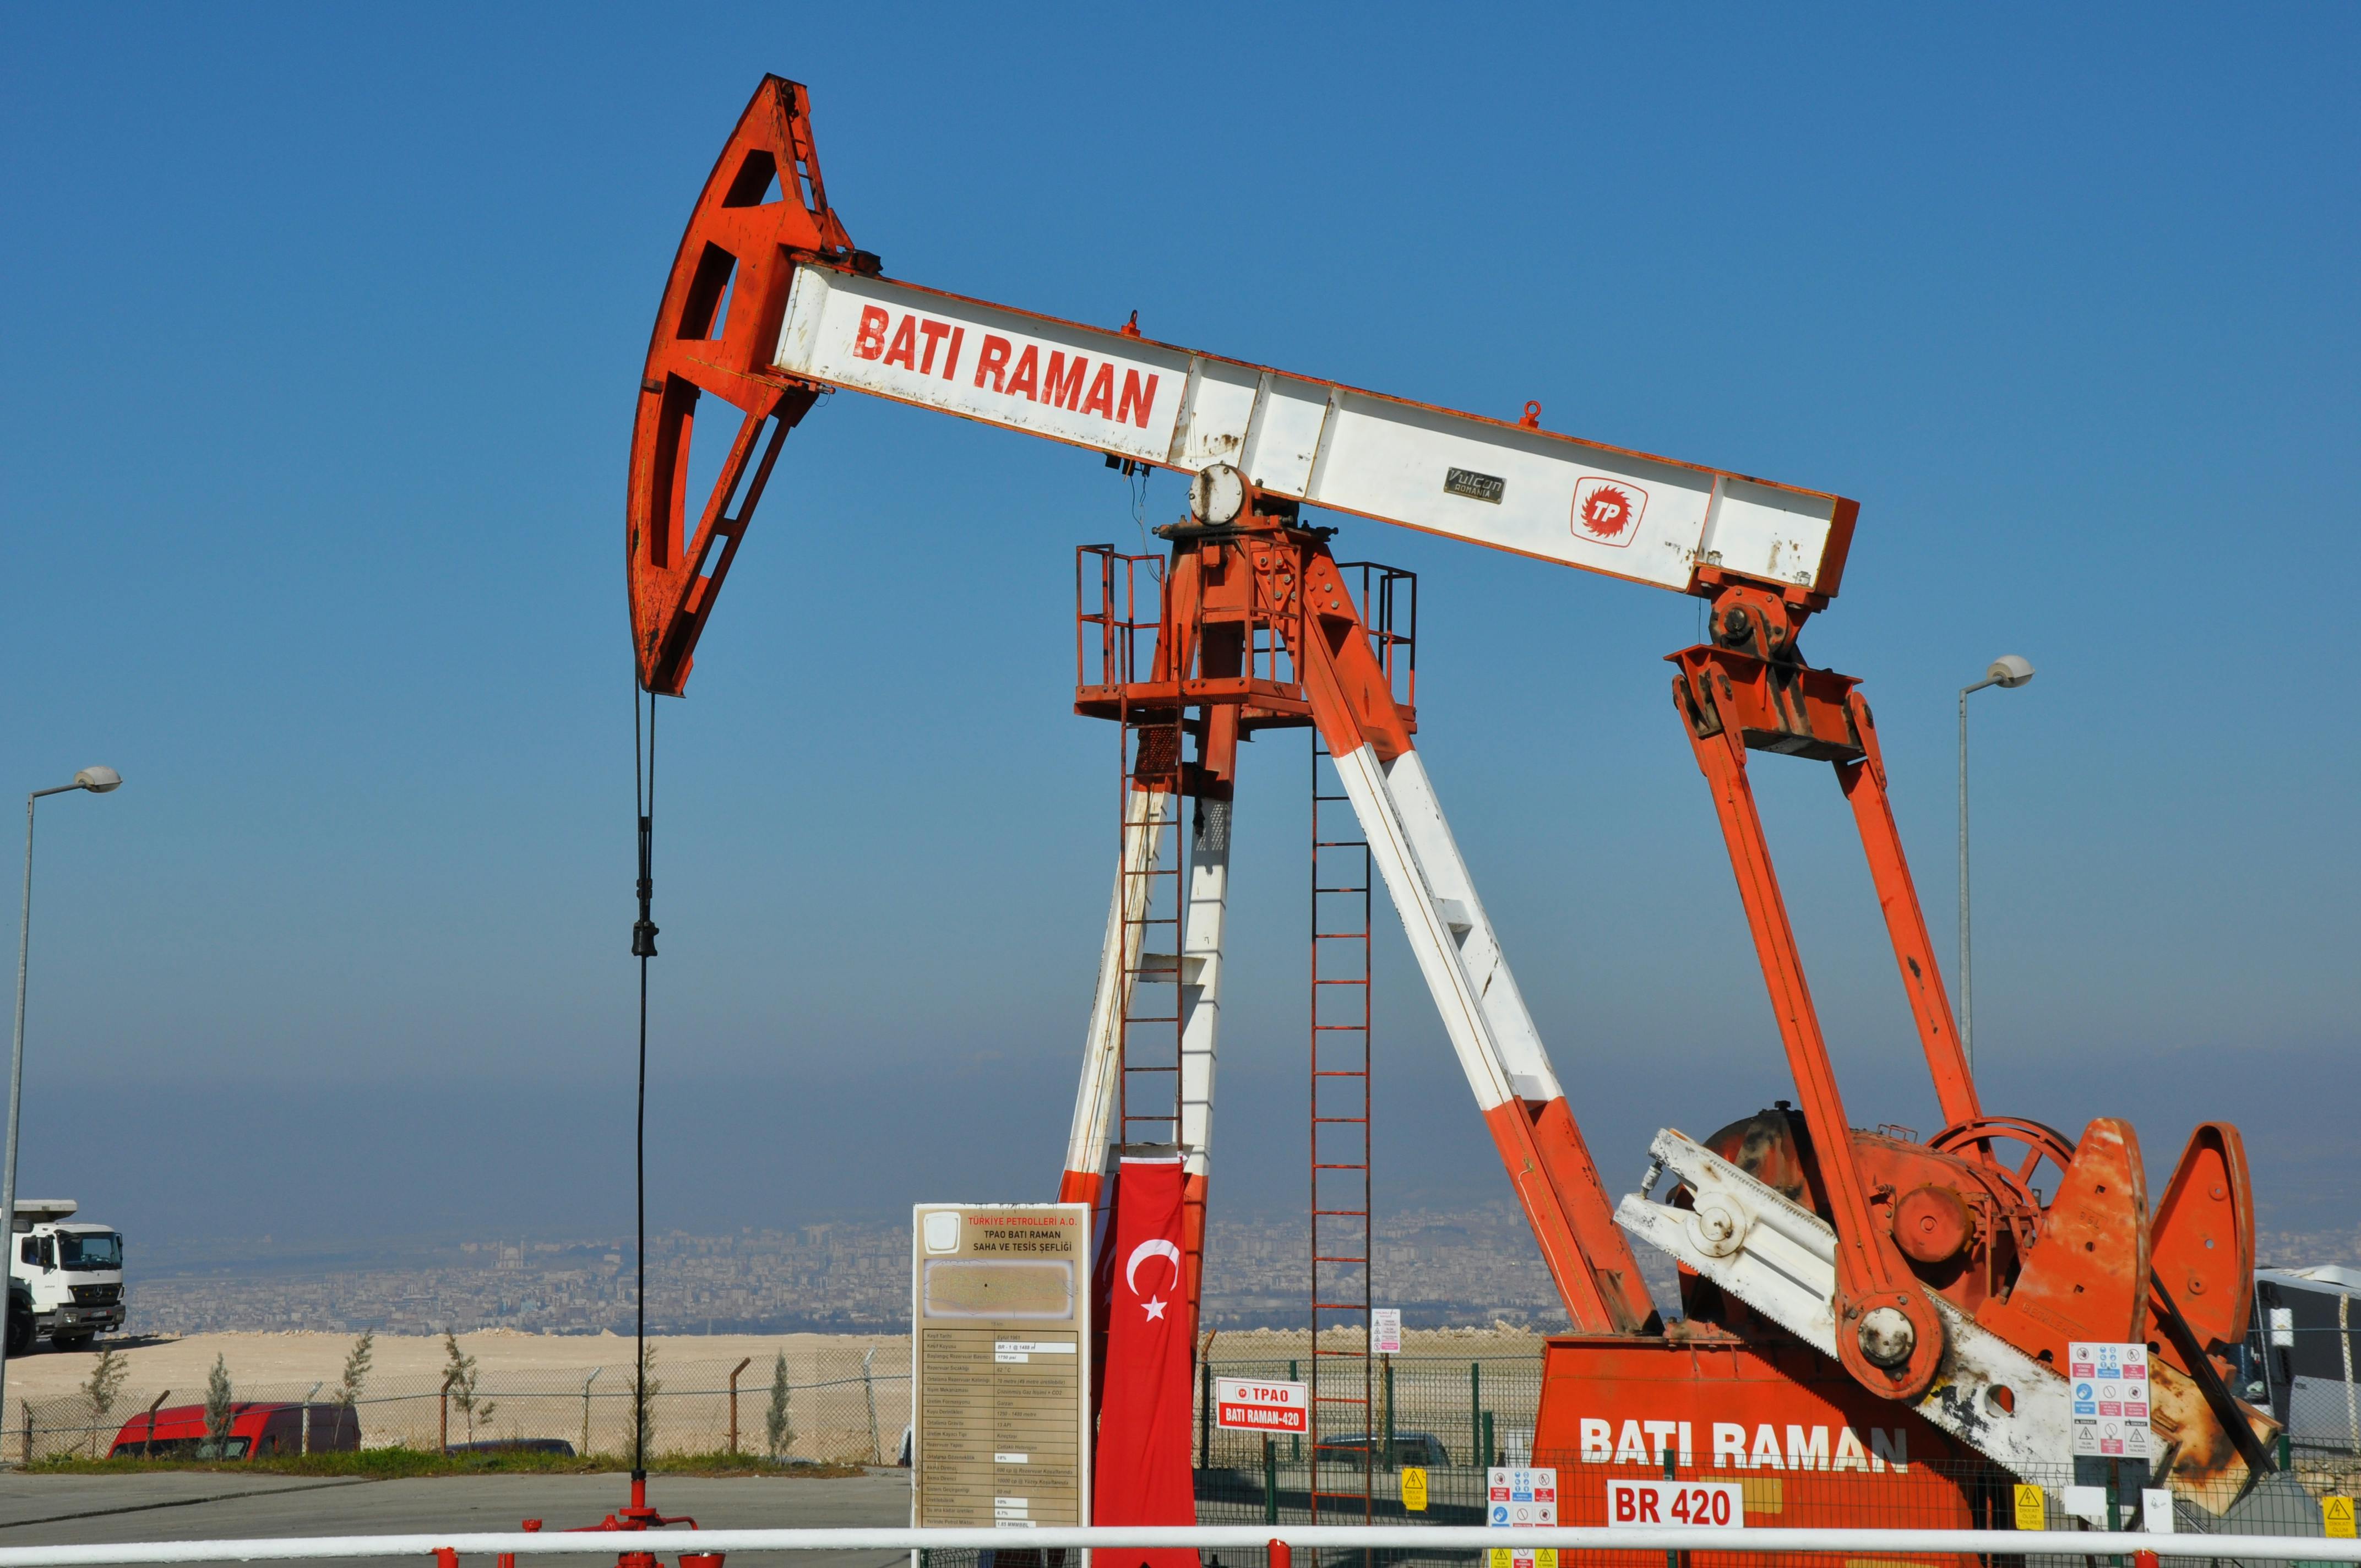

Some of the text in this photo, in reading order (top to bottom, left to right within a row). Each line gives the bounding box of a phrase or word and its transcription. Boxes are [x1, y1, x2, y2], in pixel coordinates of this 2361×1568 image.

[853, 304, 1159, 429] BATI RAMAN
[1449, 470, 1502, 491] Vulcan
[1455, 484, 1490, 498] ROMANIA
[1592, 500, 1620, 522] TP
[969, 1216, 1077, 1226] TÜRKİYE PETROLLERİ A.O.
[1013, 1242, 1036, 1251] TESİS
[1040, 1242, 1071, 1254] ŞEFLİĞİ
[1253, 1388, 1288, 1402] TPAO
[1226, 1408, 1299, 1427] BATI RAMAN-420
[1580, 1418, 1908, 1474] BATI RAMAN
[1615, 1488, 1730, 1526] BR 420
